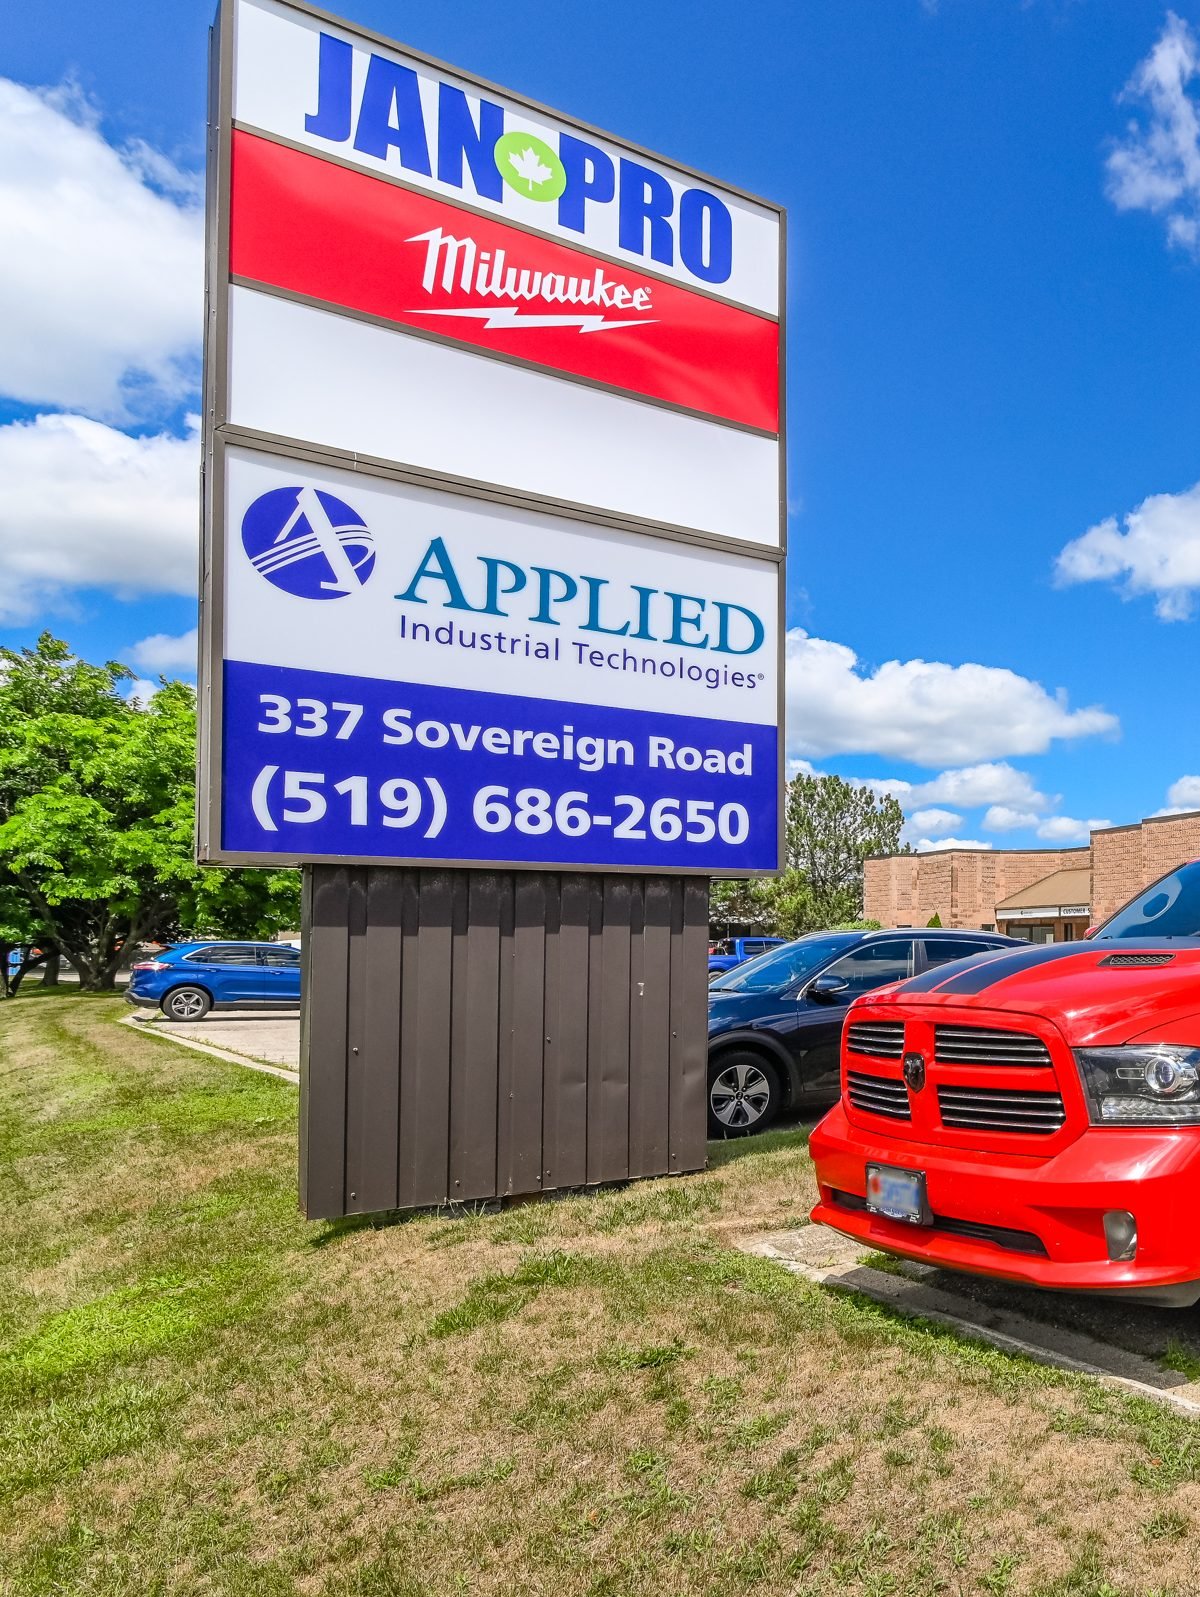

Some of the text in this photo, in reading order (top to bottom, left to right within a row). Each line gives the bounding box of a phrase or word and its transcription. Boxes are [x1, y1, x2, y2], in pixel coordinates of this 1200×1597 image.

[304, 32, 732, 284] JAN PRO
[394, 536, 765, 655] APPLIED
[400, 614, 560, 661] Industrial
[257, 694, 753, 776] 337 Sovereign Road
[251, 764, 750, 845] (519) 686-2650
